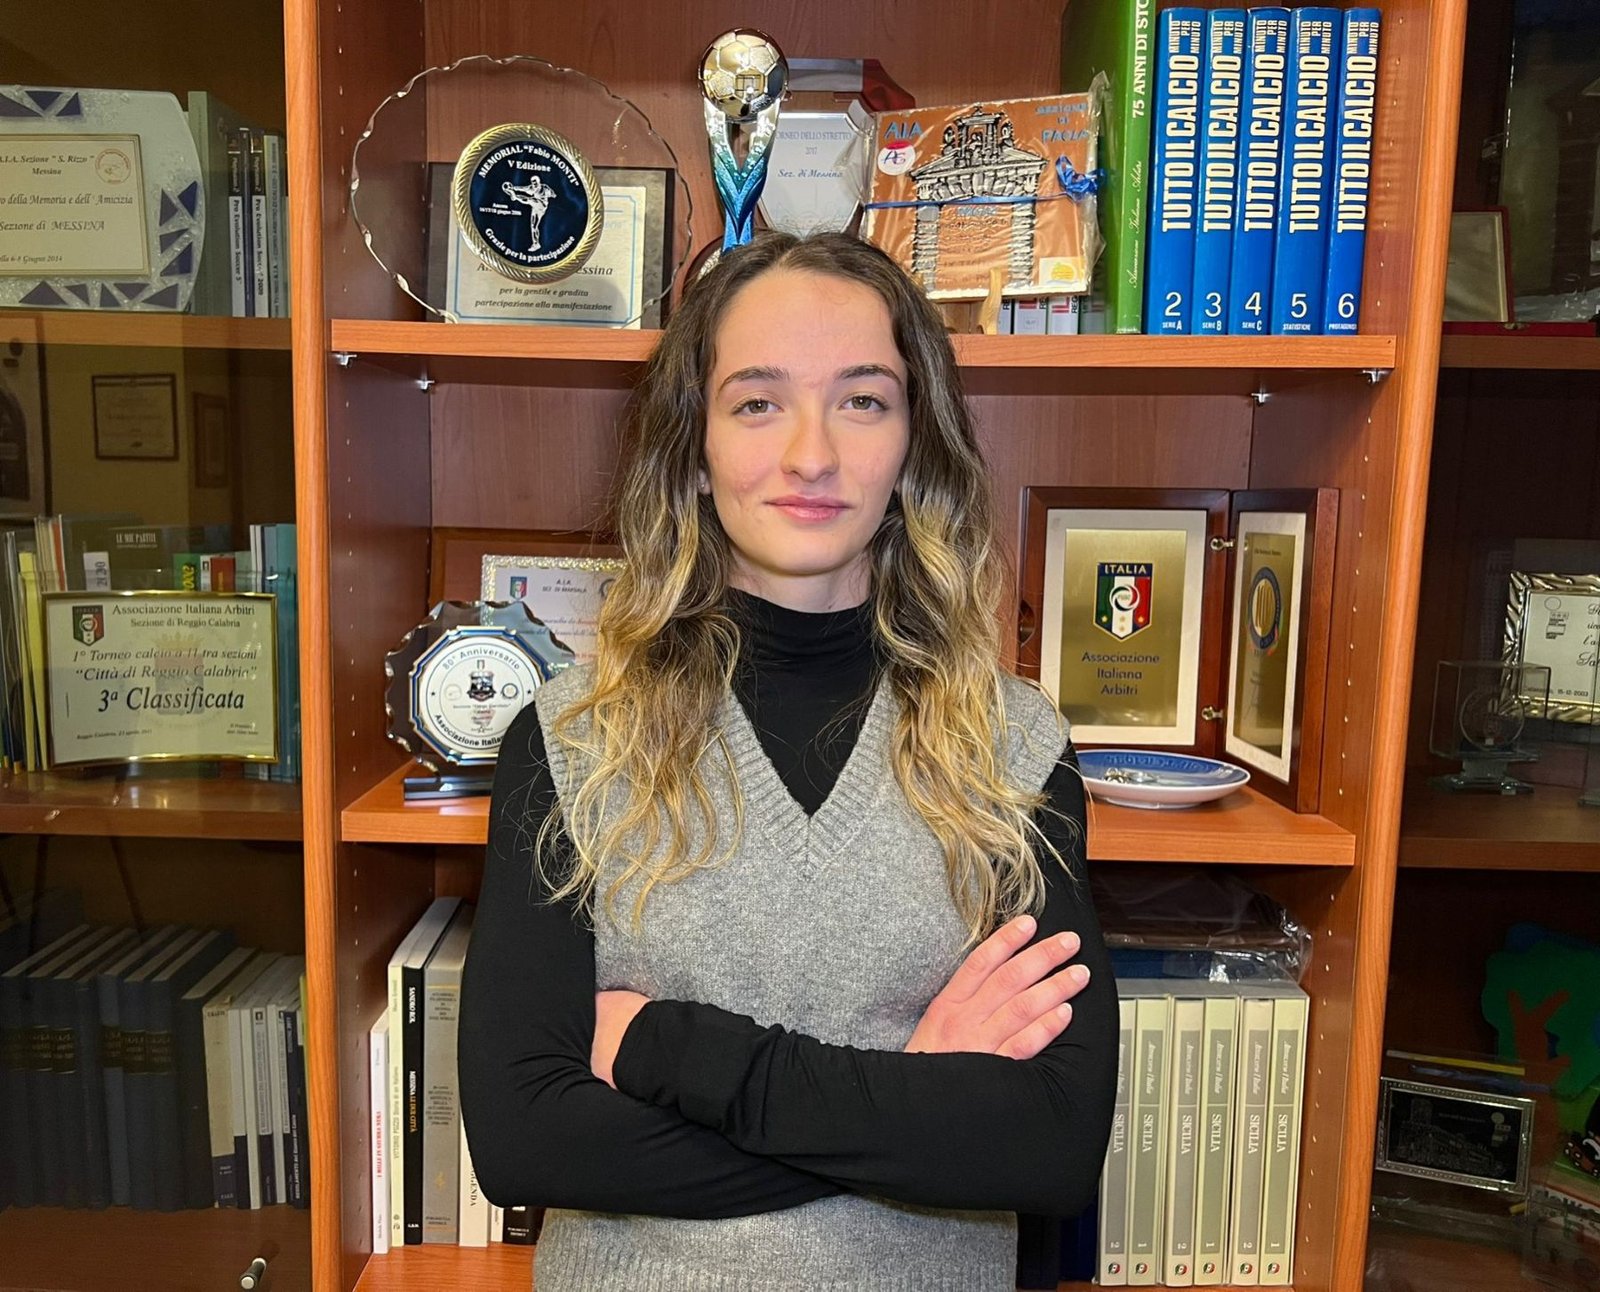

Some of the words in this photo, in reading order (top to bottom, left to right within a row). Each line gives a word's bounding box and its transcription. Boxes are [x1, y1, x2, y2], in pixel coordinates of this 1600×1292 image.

[1135, 32, 1148, 47] DI
[1169, 20, 1181, 53] MINUTO
[1181, 21, 1191, 36] PER
[1190, 21, 1201, 54] MINUTO
[1212, 21, 1223, 53] MINUTO
[1224, 21, 1234, 36] PER
[1233, 21, 1244, 54] MINUTO
[1254, 20, 1267, 52] MINUTO
[1266, 20, 1278, 35] PER
[1276, 20, 1287, 53] MINUTO
[1299, 21, 1311, 54] MINUTO
[1311, 21, 1322, 36] PER
[1321, 21, 1332, 54] MINUTO
[1347, 22, 1359, 54] MINUTO
[1359, 22, 1370, 37] PER
[1368, 22, 1379, 54] MINUTO
[1133, 48, 1147, 96] ANNI
[1166, 55, 1199, 137] CALCIO
[1208, 55, 1242, 137] CALCIO
[1250, 54, 1285, 137] CALCIO
[1294, 55, 1330, 138] CALCIO
[1342, 55, 1377, 138] CALCIO
[1132, 99, 1145, 118] 75
[777, 131, 800, 140] ORNEO
[821, 131, 852, 140] STRETTO
[882, 121, 923, 140] AIA
[21, 155, 49, 163] Sezione
[1165, 140, 1196, 158] IL
[1207, 140, 1238, 159] IL
[1248, 139, 1279, 158] IL
[1293, 140, 1324, 159] IL
[1341, 141, 1371, 159] IL
[478, 145, 523, 178] MEMORIAL
[507, 160, 515, 168] V
[516, 160, 552, 172] Edizione
[798, 169, 807, 178] di
[807, 169, 843, 178] Messina
[8, 192, 28, 205] della
[29, 194, 66, 205] Memoria
[95, 194, 133, 206] Amicizia
[1162, 161, 1195, 232] TUTTO
[1203, 162, 1235, 232] TUTTO
[1244, 162, 1277, 232] TUTTO
[1289, 163, 1323, 233] TUTTO
[1337, 163, 1369, 233] TUTTO
[0, 220, 34, 231] Sezione
[36, 220, 46, 231] di
[51, 220, 105, 231] MESSINA
[485, 227, 507, 252] Grazie
[505, 248, 519, 259] per
[519, 251, 527, 261] la
[527, 235, 576, 263] partecipazione
[575, 264, 613, 275] essina
[475, 299, 534, 309] partecipazione
[535, 300, 551, 309] alla
[552, 302, 613, 311] manifestazione
[499, 287, 513, 297] per
[513, 287, 522, 295] la
[524, 287, 551, 297] gentile
[559, 288, 589, 298] gradita
[1164, 291, 1183, 316] 2
[1205, 292, 1222, 317] 3
[1244, 291, 1262, 316] 4
[1290, 293, 1308, 318] 5
[1337, 293, 1355, 318] 6
[1176, 322, 1183, 331] A
[1216, 322, 1222, 331] B
[1256, 322, 1262, 331] C
[1282, 323, 1311, 331] STATISTICHE
[1104, 563, 1148, 575] ITALIA
[112, 604, 183, 616] Associazione
[185, 603, 222, 615] Italiana
[224, 603, 255, 615] Arbitri
[130, 618, 165, 628] Sezione
[167, 618, 175, 627] di
[177, 618, 207, 630] Reggio
[208, 618, 241, 628] Calabria
[90, 650, 132, 661] Torneo
[135, 648, 172, 660] calcio
[174, 652, 182, 660] a
[202, 650, 218, 660] tra
[221, 650, 257, 661] sezioni
[460, 647, 520, 670] Anniversario
[1081, 651, 1160, 664] Associazione
[122, 665, 136, 679] di
[141, 666, 189, 681] Reggio
[1096, 667, 1143, 680] Italiana
[126, 686, 245, 714] Classificata
[1100, 683, 1138, 696] Arbitri
[435, 714, 480, 746] Associazione
[409, 1070, 417, 1095] MESSINA
[410, 1115, 418, 1133] CITTÀ
[1112, 1113, 1125, 1154] SICILIA
[1141, 1112, 1155, 1153] SICILIA
[1180, 1114, 1193, 1155] SICILIA
[1209, 1112, 1222, 1153] SICILIA
[1247, 1114, 1260, 1155] SICILIA
[1276, 1113, 1289, 1153] SICILIA
